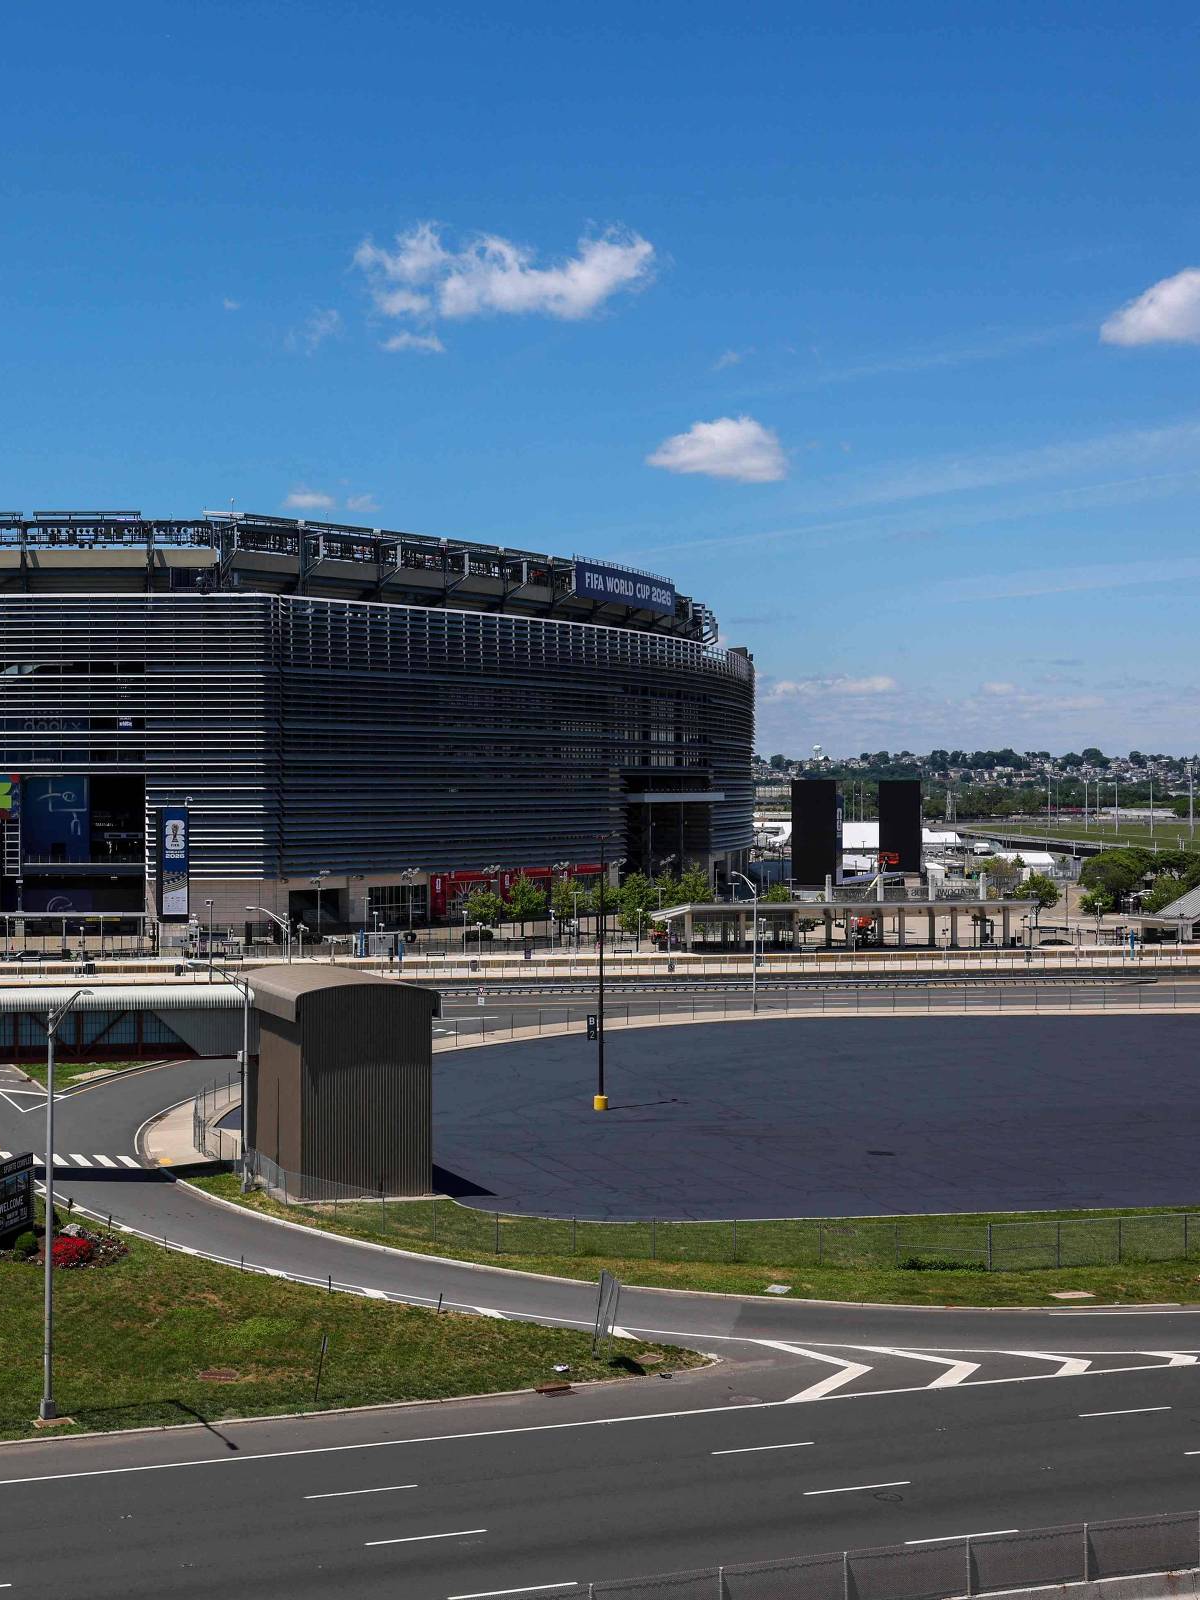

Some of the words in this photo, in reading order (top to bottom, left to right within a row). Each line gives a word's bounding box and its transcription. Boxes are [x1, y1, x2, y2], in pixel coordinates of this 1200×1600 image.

[585, 571, 605, 591] FIFA
[605, 575, 634, 597] WORLD
[636, 583, 650, 599] CUP
[651, 586, 672, 606] 2026
[589, 1017, 595, 1025] B
[590, 1030, 595, 1039] 2
[3, 1162, 17, 1174] SPORTS
[17, 1156, 32, 1169] COMPLEX
[0, 1196, 23, 1214] WELCOME
